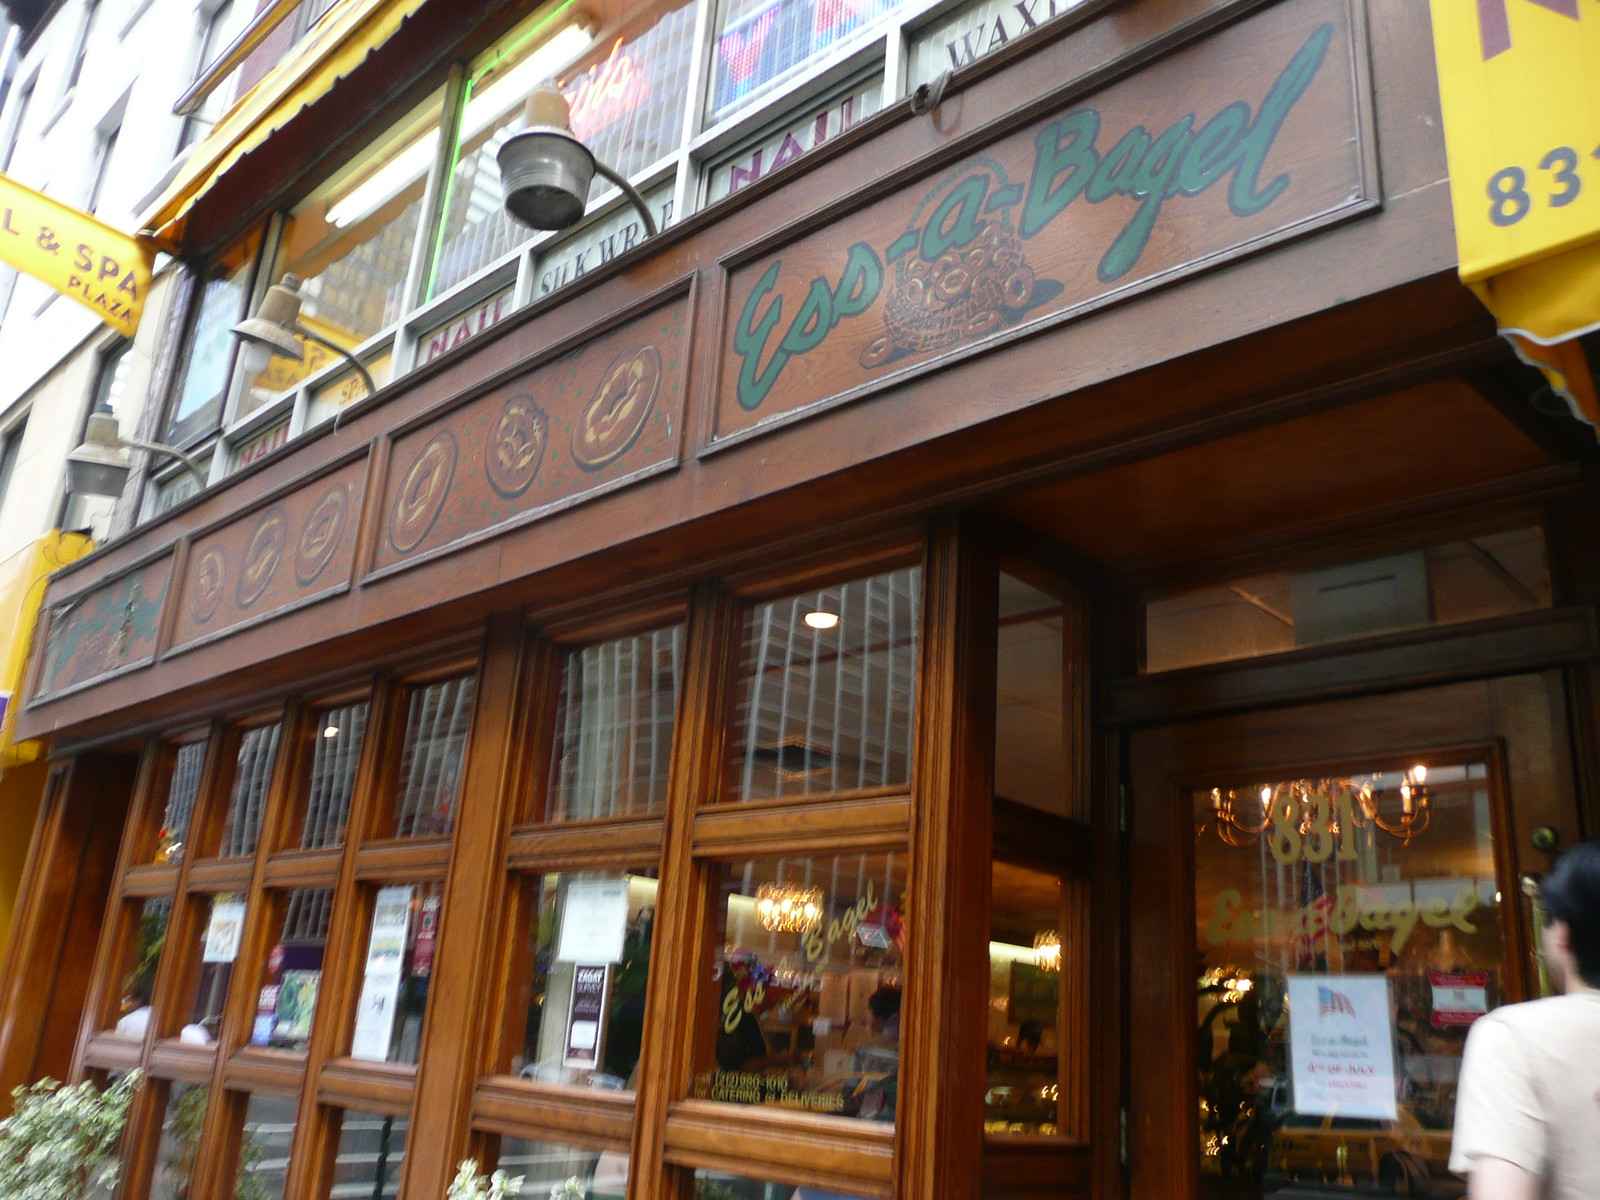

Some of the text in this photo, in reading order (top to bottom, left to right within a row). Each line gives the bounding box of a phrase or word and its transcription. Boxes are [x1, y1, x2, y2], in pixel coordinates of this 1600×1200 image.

[733, 22, 1334, 411] Ess-a-Bagel
[1486, 146, 1600, 227] 83
[36, 226, 61, 256] &
[74, 243, 138, 303] SPA
[599, 199, 674, 266] WRP
[66, 274, 132, 326] PLAZA
[1271, 791, 1359, 865] 831
[801, 879, 879, 962] Bagel
